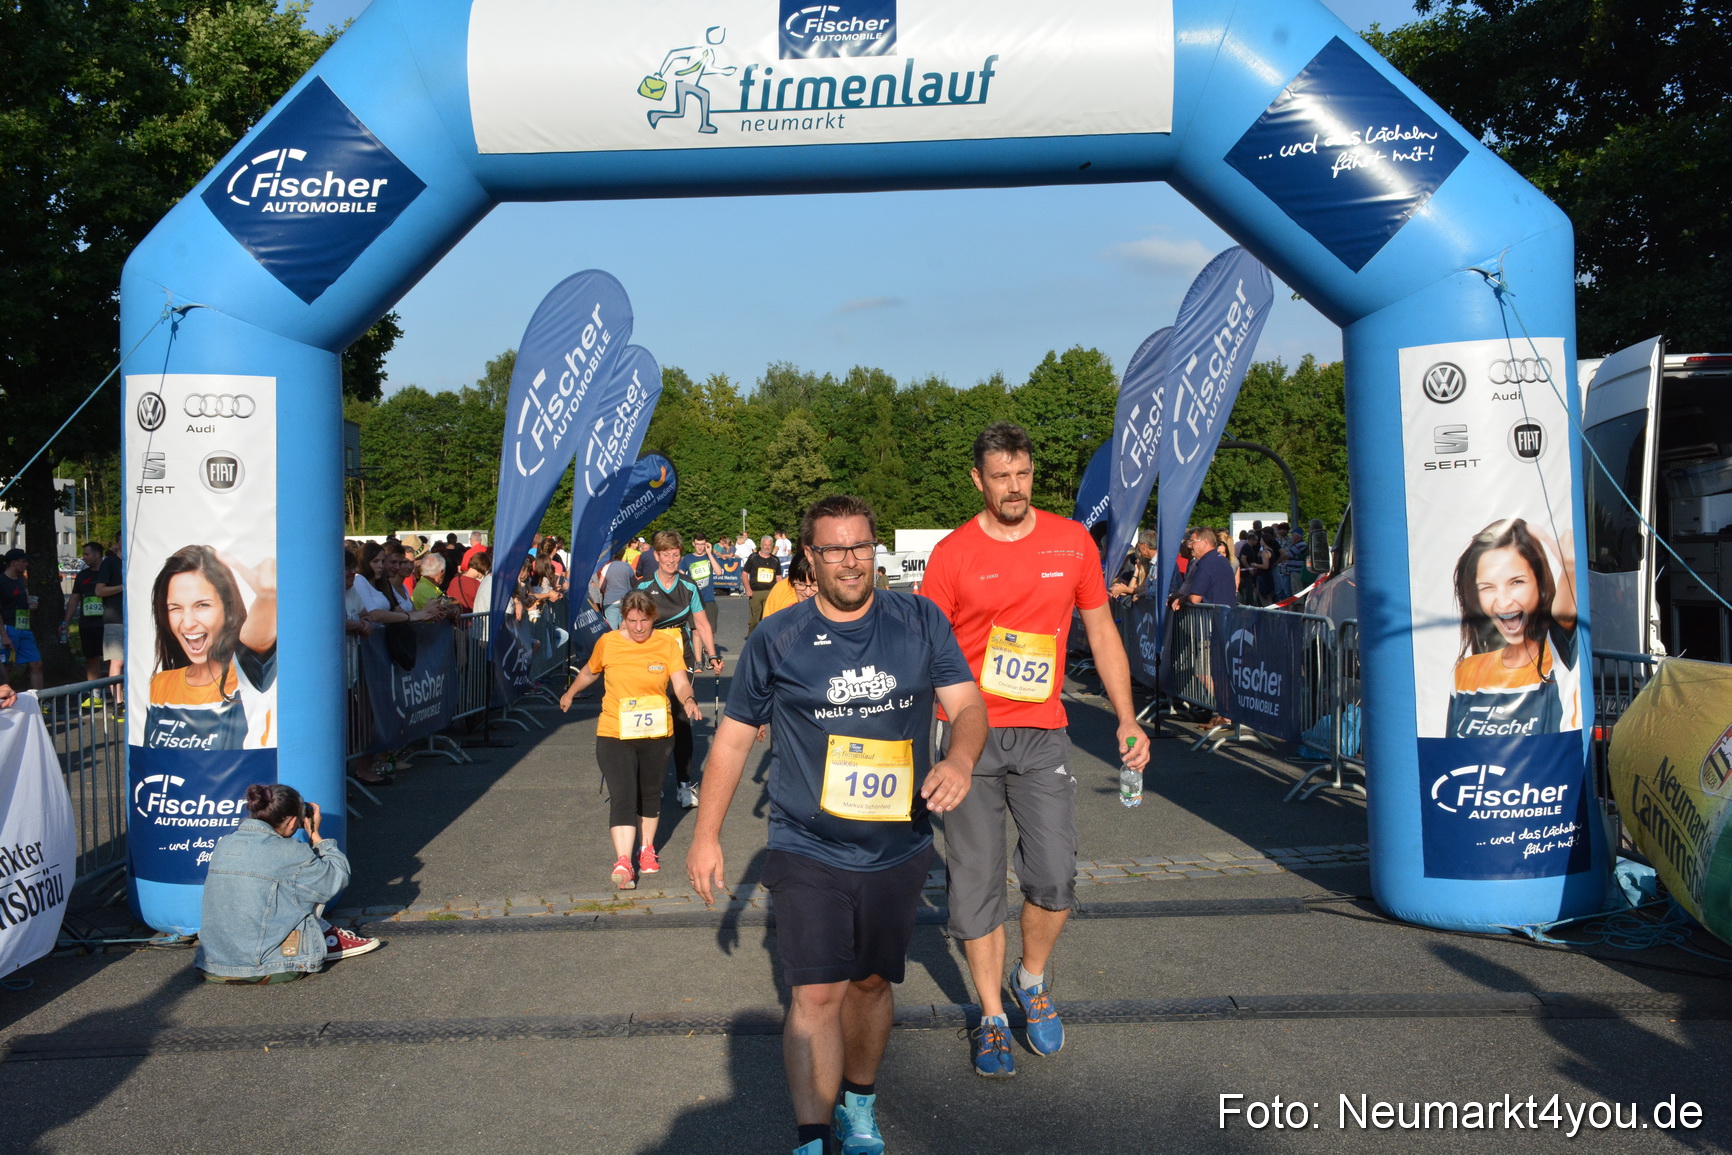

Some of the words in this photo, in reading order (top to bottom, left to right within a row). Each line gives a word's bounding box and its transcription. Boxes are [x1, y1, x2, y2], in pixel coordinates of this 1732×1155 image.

[804, 16, 889, 33] Fischer
[812, 32, 882, 43] AUTOMOBILE
[739, 54, 999, 111] firmenlauf
[740, 112, 846, 132] neumarkt
[1365, 124, 1438, 145] Lächeln
[1392, 145, 1435, 162] mit!
[251, 171, 388, 198] Fischer
[261, 201, 378, 213] AUTOMOBILE
[1186, 279, 1247, 438] Fischer
[531, 303, 604, 452] Fischer
[1206, 304, 1254, 434] AUTOMOBILE
[552, 328, 611, 450] AUTOMOBILE
[1491, 390, 1521, 401] Audi
[186, 424, 216, 433] Audi
[596, 369, 642, 478] Fischer
[1517, 430, 1540, 451] FIAT
[210, 463, 235, 482] FIAT
[1424, 458, 1481, 471] SEAT
[136, 485, 175, 494] SEAT
[993, 654, 1049, 684] 1052
[1232, 657, 1282, 697] Fischer
[401, 669, 445, 708] Fischer
[828, 672, 896, 704] Burgis
[814, 706, 853, 719] Weil's
[859, 699, 895, 718] guad
[899, 695, 914, 709] is!
[633, 712, 654, 727] 75
[1466, 717, 1538, 736] Fischer
[155, 731, 218, 750] Fischer
[842, 750, 876, 760] firmenlauf
[845, 771, 897, 798] 190
[147, 792, 248, 815] Fischer
[1457, 783, 1568, 806] Fischer
[1468, 805, 1562, 819] AUTOMOBILE
[154, 816, 239, 828] AUTOMOBILE
[169, 838, 190, 851] und
[192, 836, 215, 849] das
[1490, 831, 1515, 846] und
[1519, 828, 1541, 841] das
[1523, 843, 1556, 859] fährt
